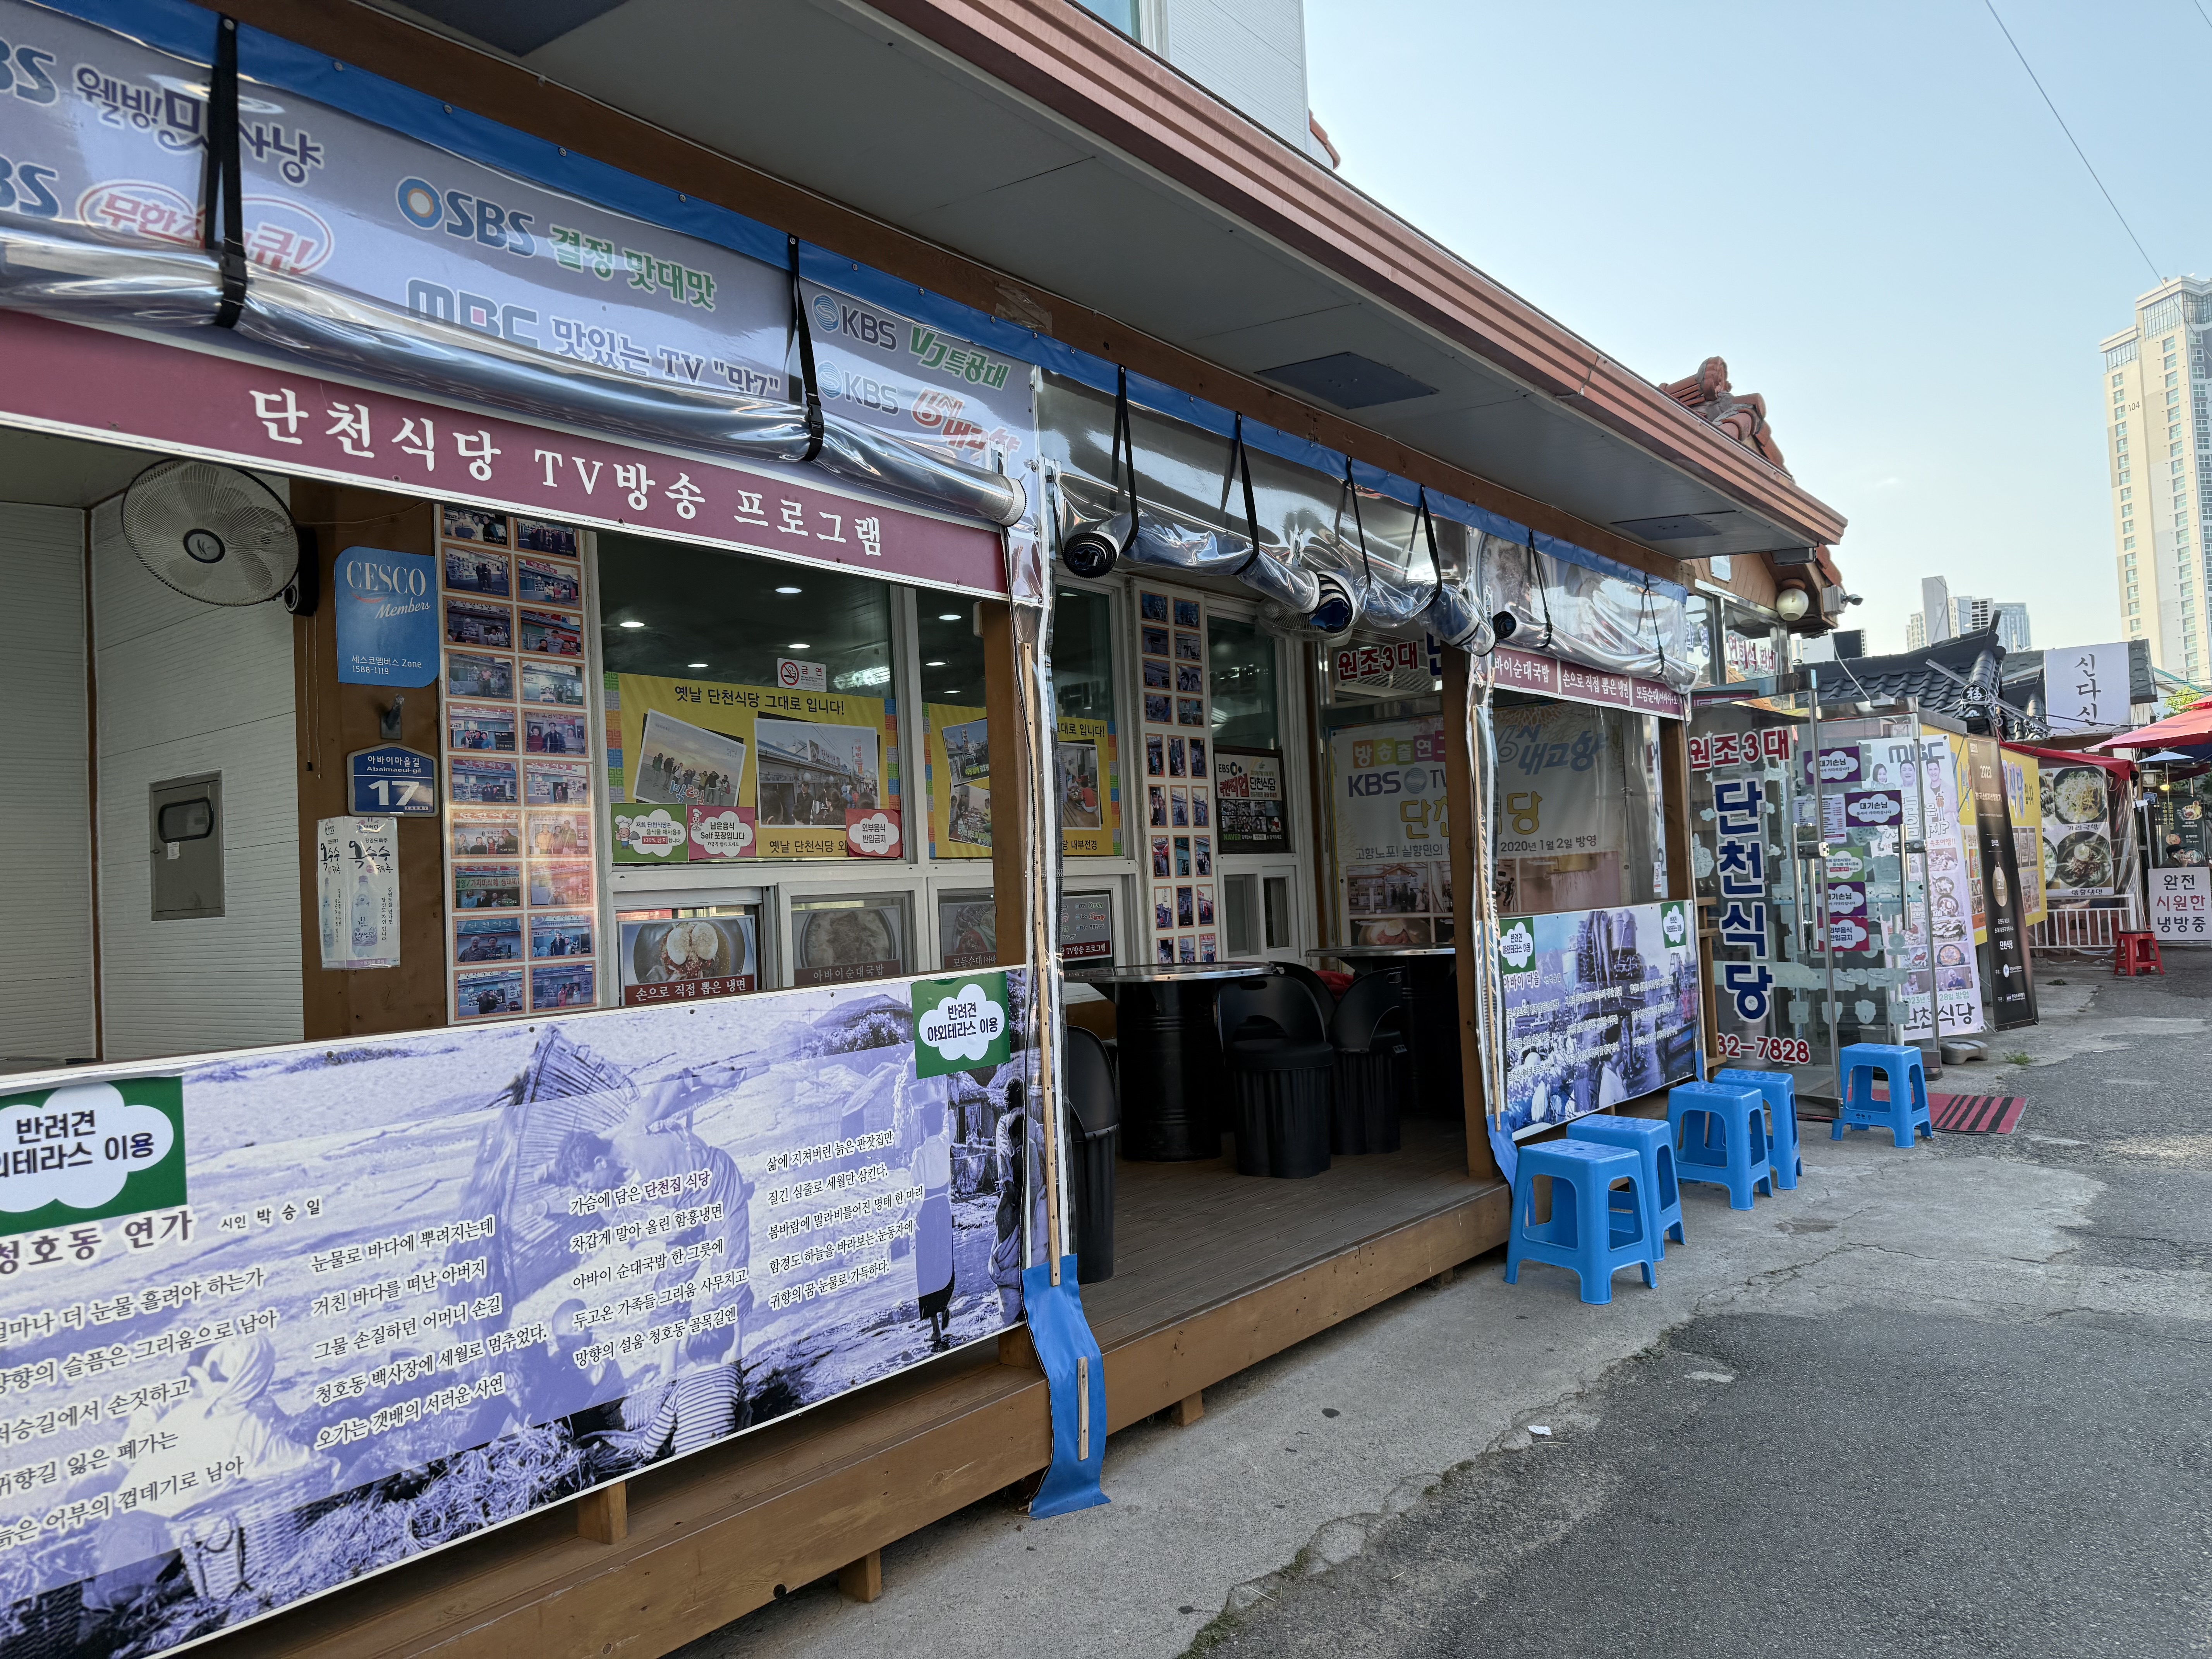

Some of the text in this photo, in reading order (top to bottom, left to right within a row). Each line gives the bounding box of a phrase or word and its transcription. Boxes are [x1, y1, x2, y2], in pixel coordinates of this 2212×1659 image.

[445, 190, 716, 311] SBS 결정 맛대맛
[407, 280, 705, 384] MBC 맛있는 TV
[841, 304, 1010, 390] KBS VJ특공대
[843, 372, 899, 416] KBS
[249, 388, 502, 481] 단천식당
[733, 489, 882, 556] 프로그램
[347, 560, 426, 597] CESCO
[375, 597, 431, 620] Members
[351, 654, 422, 669] 세스코멤버스 Zone
[352, 665, 390, 675] 1588-1119
[1338, 641, 1418, 682] 원조3대
[1494, 654, 1550, 684] 바이순대국밥
[1562, 669, 1629, 699] 손으로 직접 뽑은 냉면
[1966, 686, 1982, 701] 福
[2074, 654, 2102, 726] 신다신
[675, 685, 845, 715] 옛날 단천식당 그대로 입니다!
[1079, 723, 1105, 738] 입니다!
[1518, 730, 1609, 776] 내고향
[1690, 728, 1791, 771] 원조3대
[1888, 742, 1945, 764] MBC
[367, 755, 421, 768] 아바이마을길
[1218, 764, 1230, 773] EBS
[1819, 758, 1846, 767] 대기손님
[1980, 764, 1992, 779] 2023
[368, 780, 419, 807] 17
[1250, 776, 1276, 791] 단천식당
[1348, 771, 1401, 798] KBS
[1860, 801, 1888, 810] 대기손님
[701, 831, 745, 840] Self 포장입니다
[710, 822, 735, 830] 남은음식
[862, 823, 886, 833] 외부음식
[2068, 823, 2099, 831] 가리국밥
[769, 839, 834, 854] 옛날 단천식당
[862, 833, 886, 844] 반입금지
[1071, 840, 1098, 851] 내부전경
[1501, 834, 1597, 852] 2020년 1월 2일 방영
[1355, 843, 1443, 860] 고향노포! 실향민의
[501, 876, 519, 887] 생태찌
[2163, 874, 2195, 891] 완전
[1713, 779, 1775, 1022] 단천식당
[2157, 895, 2205, 912] 시원한
[2157, 916, 2206, 933] 냉방중
[1085, 943, 1106, 953] 프로그램
[813, 963, 885, 982] 아바이순대국밥
[1503, 972, 1540, 992] 아바이 마을
[635, 976, 747, 1003] 손으로 직접 뽑은 냉면
[1939, 991, 1969, 1001] 28일 방영
[947, 1001, 977, 1021] 반려견
[927, 1016, 998, 1042] 야외테라스 이용
[16, 1109, 96, 1144] 반려견
[0, 1132, 154, 1178] 테라스 이용
[766, 1130, 894, 1172] 삶에 지쳐버린 늙은 판잣집만
[570, 1170, 712, 1215] 가슴에 담은 단천집 식당
[124, 1210, 193, 1249] 연가
[221, 1214, 247, 1230] 시인
[311, 1217, 494, 1273] 눈물로 바다에 뿌려지는데
[770, 1260, 890, 1309] 귀향의 꿈 눈물로 가득하다.
[64, 1267, 264, 1327] 더 눈물 흘려야 하는가
[574, 1306, 737, 1367] 망향의 설움 청호동 골목길엔
[316, 1375, 503, 1449] 오가는 갯배의 서러운 사연
[46, 1495, 110, 1530] 어부의
[118, 1471, 199, 1510] 껍데기로
[206, 1456, 245, 1483] 남아
